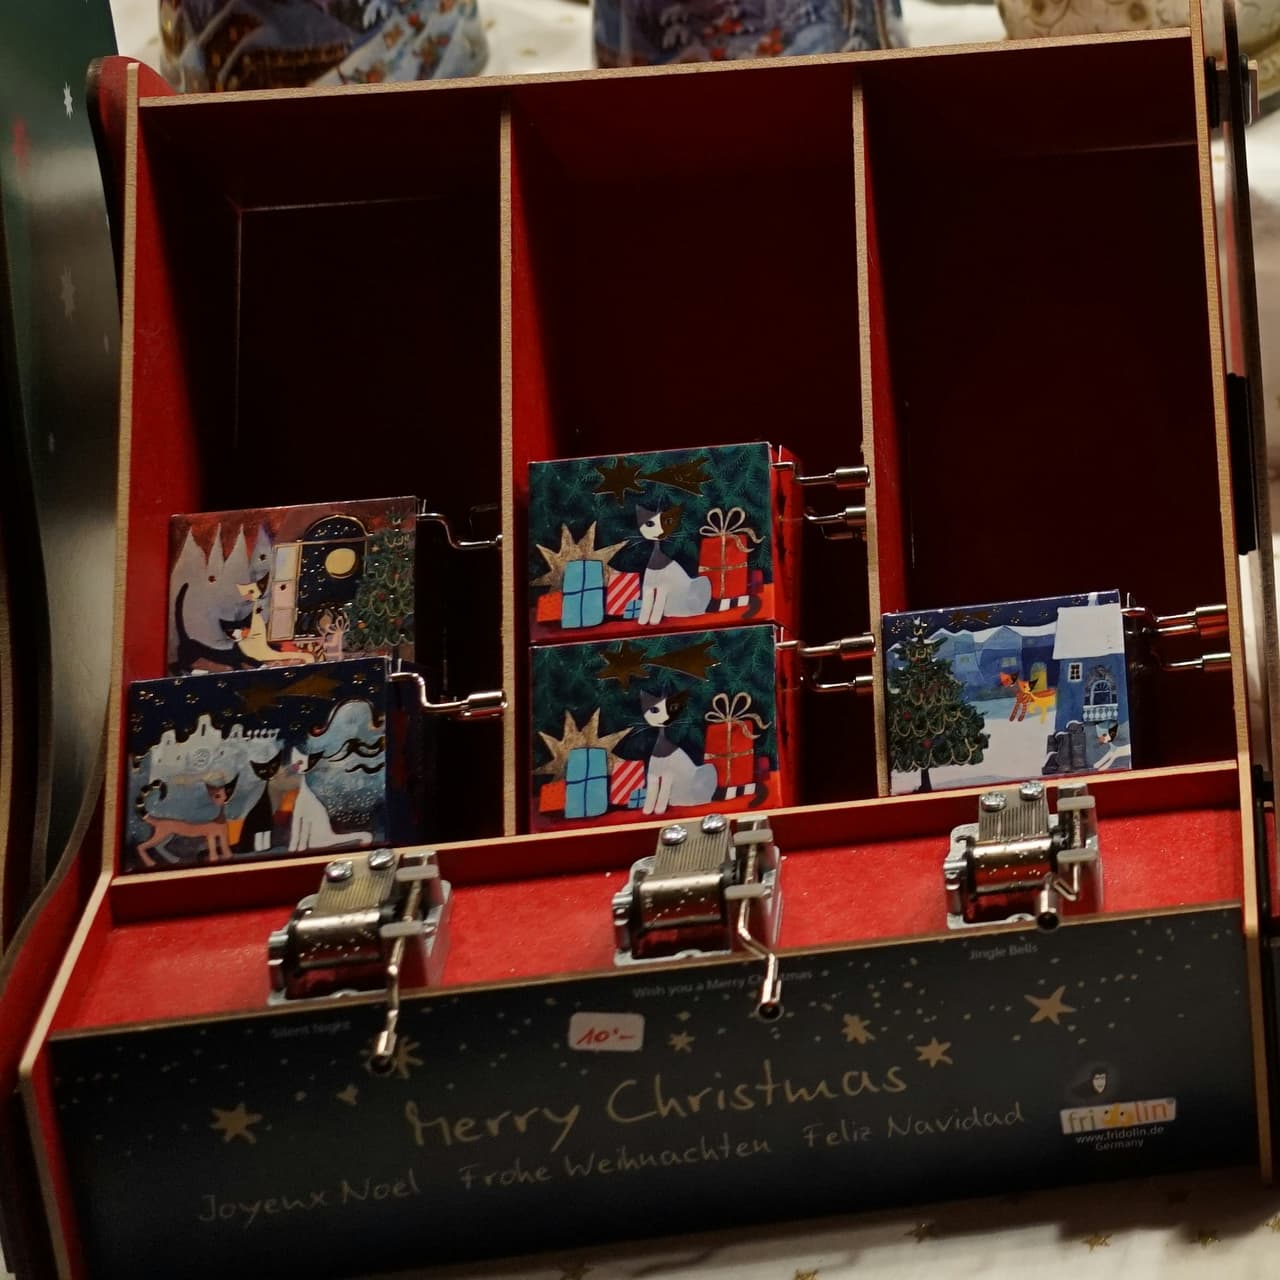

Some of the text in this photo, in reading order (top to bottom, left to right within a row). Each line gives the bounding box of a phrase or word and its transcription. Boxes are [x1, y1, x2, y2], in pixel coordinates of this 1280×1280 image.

[405, 1058, 908, 1152] Merry Christmas
[1075, 1125, 1165, 1144] www.fridolin.de
[1095, 1138, 1145, 1152] Germany
[198, 1188, 328, 1228] Joyeux
[459, 1161, 551, 1192] Frohe
[564, 1131, 772, 1178] Weihnachten
[803, 1120, 872, 1150] Feliz
[886, 1102, 1025, 1139] Navidad
